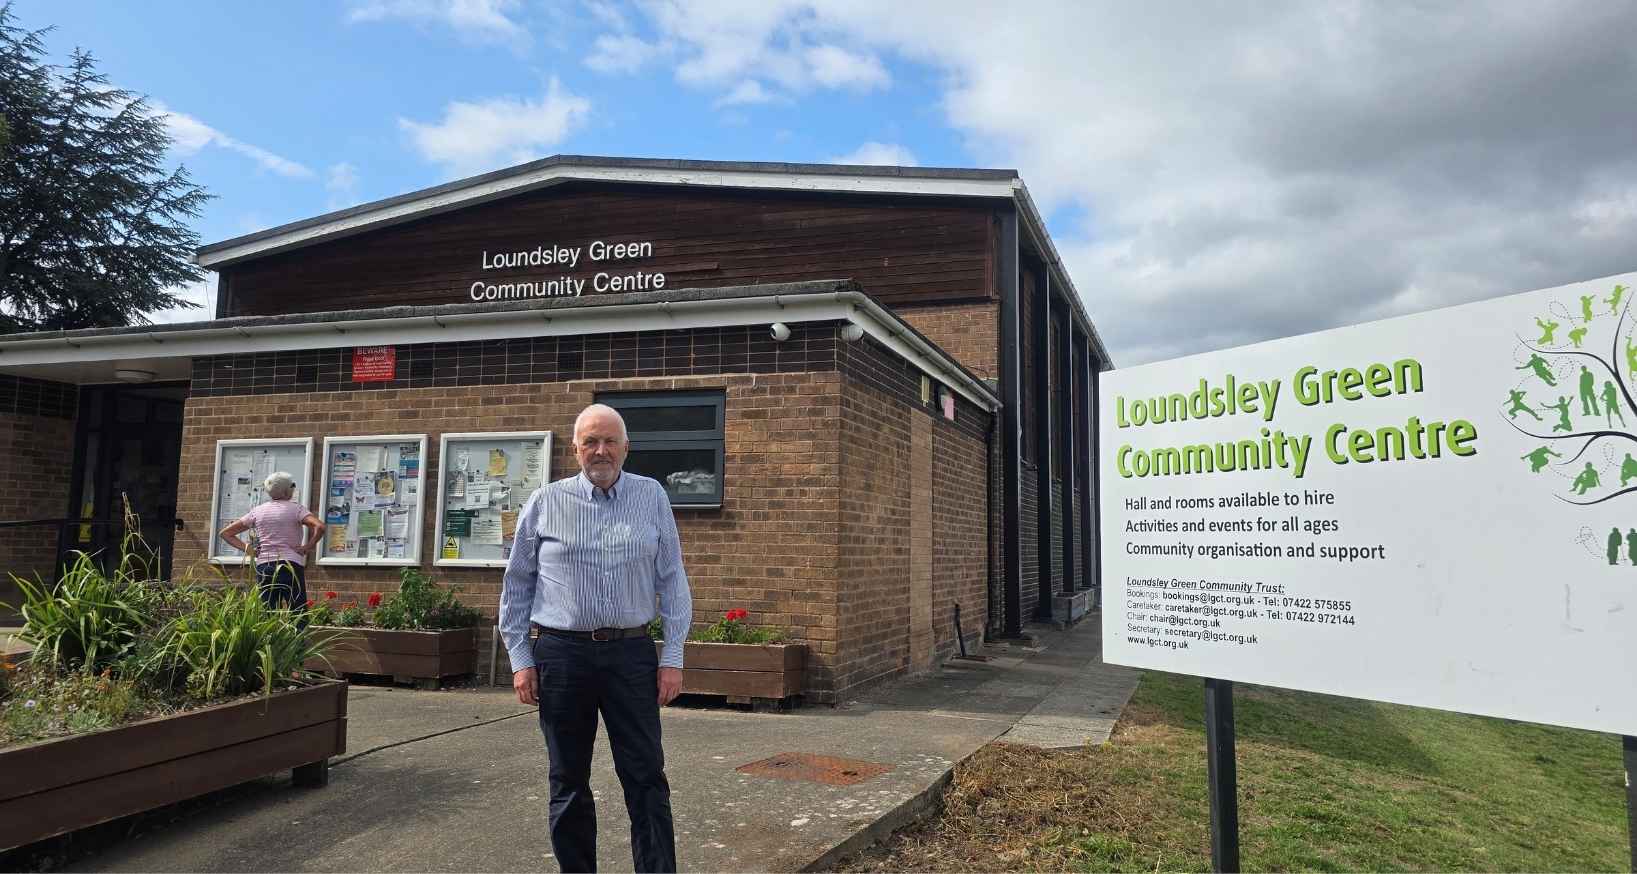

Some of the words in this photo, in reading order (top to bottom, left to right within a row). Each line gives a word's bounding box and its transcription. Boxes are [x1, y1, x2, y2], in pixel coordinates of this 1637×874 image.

[482, 245, 581, 269] Loundsley
[589, 241, 652, 261] Green
[470, 276, 585, 300] Community
[594, 271, 665, 292] Centre
[1116, 374, 1281, 428] Loundsley
[1293, 357, 1424, 406] Green
[1116, 427, 1312, 478] Community
[1325, 415, 1478, 465] Centre
[1125, 497, 1147, 510] Hall
[1150, 496, 1172, 510] and
[1175, 497, 1215, 509] rooms
[1218, 492, 1280, 508] available
[1284, 493, 1300, 506] to
[1304, 490, 1335, 505] hire
[1125, 518, 1179, 532] Activities
[1182, 518, 1205, 532] and
[1209, 519, 1253, 532] events
[1257, 516, 1278, 532] for
[1281, 516, 1299, 531] all
[1303, 518, 1339, 535] ages
[1126, 541, 1194, 558] Community
[1197, 542, 1282, 559] organisation
[1286, 542, 1315, 558] and
[1320, 544, 1386, 562] support
[1127, 577, 1168, 589] Loundsley
[1171, 578, 1197, 589] Green
[1199, 580, 1252, 593] Community
[1256, 582, 1285, 594] Trust:
[1162, 591, 1255, 606] bookings@lgct.org.uk
[1264, 596, 1280, 606] Tel:
[1283, 597, 1311, 608] 07422
[1315, 599, 1351, 611] 575855
[1149, 614, 1221, 628] chair@lgct.org.uk
[1165, 604, 1258, 619] caretaker@lgct.org.uk
[1266, 609, 1283, 620] Tel:
[1286, 611, 1315, 622] 07422
[1318, 613, 1355, 625] 972144
[1128, 636, 1189, 649] www.lgct.org.uk
[1165, 628, 1258, 644] secretary@lgct.org.uk
